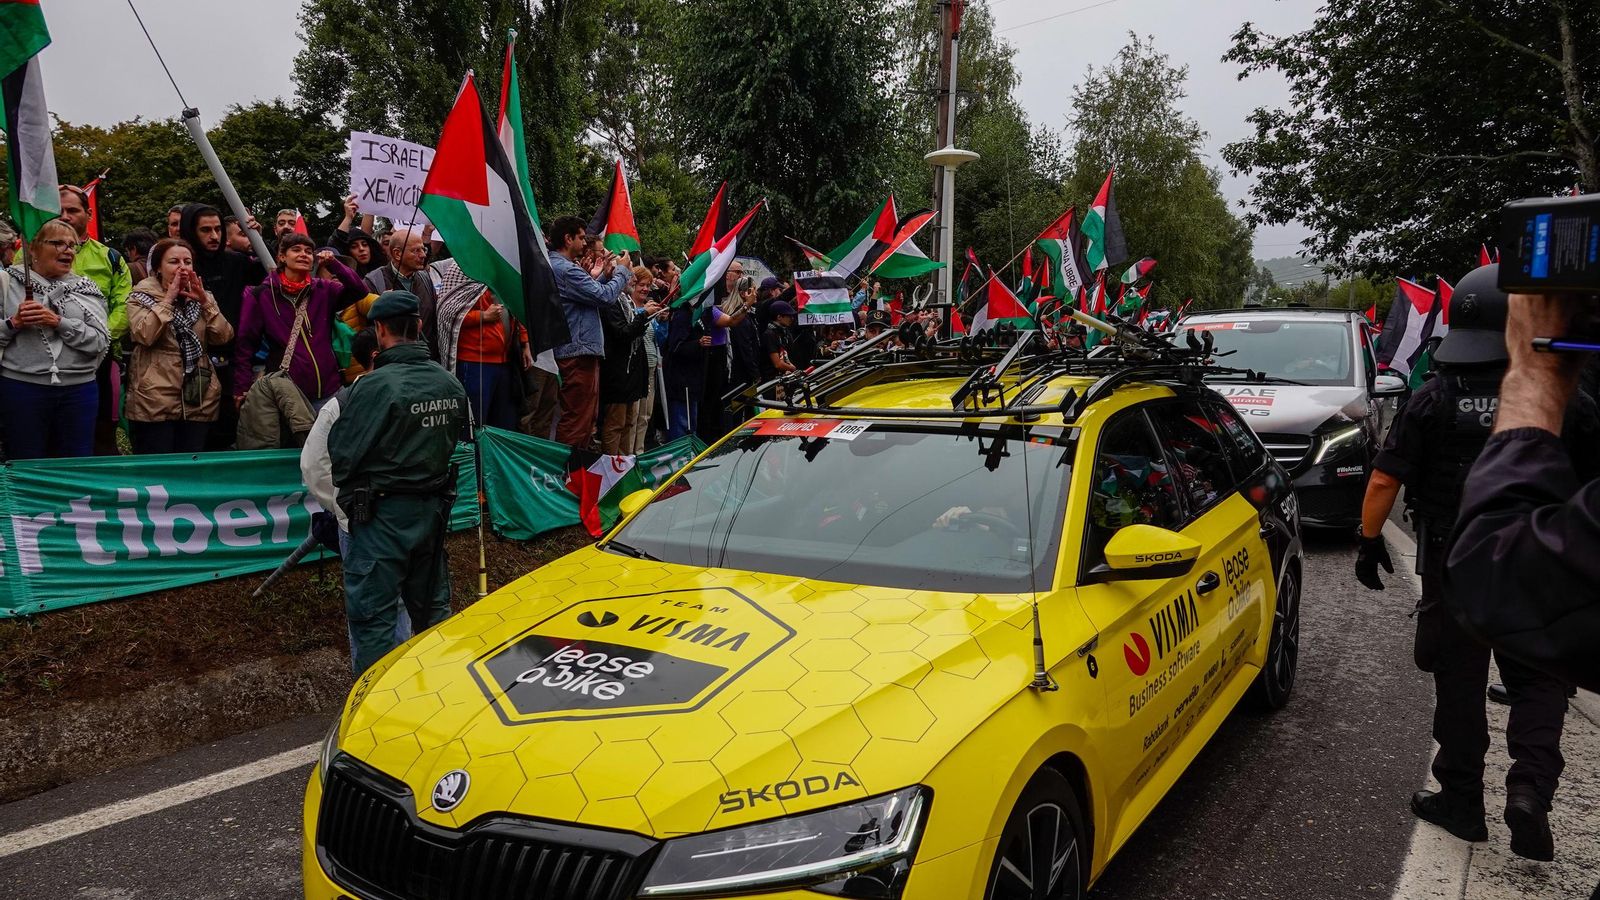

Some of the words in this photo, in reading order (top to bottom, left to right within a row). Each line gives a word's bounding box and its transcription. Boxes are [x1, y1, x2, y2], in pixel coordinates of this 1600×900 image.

[361, 140, 429, 172] ISRAEL
[363, 178, 424, 206] XENOCID
[1064, 263, 1078, 288] LIBRE
[410, 399, 459, 414] GUARDIA
[1237, 407, 1271, 417] RG
[776, 421, 819, 432] EQUIPOS
[834, 424, 864, 435] 1086
[0, 484, 325, 577] rtiber
[660, 599, 730, 614] TEAM
[627, 613, 751, 652] VISMA
[1148, 588, 1200, 660] VISMA
[542, 645, 655, 679] lease
[1129, 680, 1168, 718] Business
[1167, 639, 1201, 683] software
